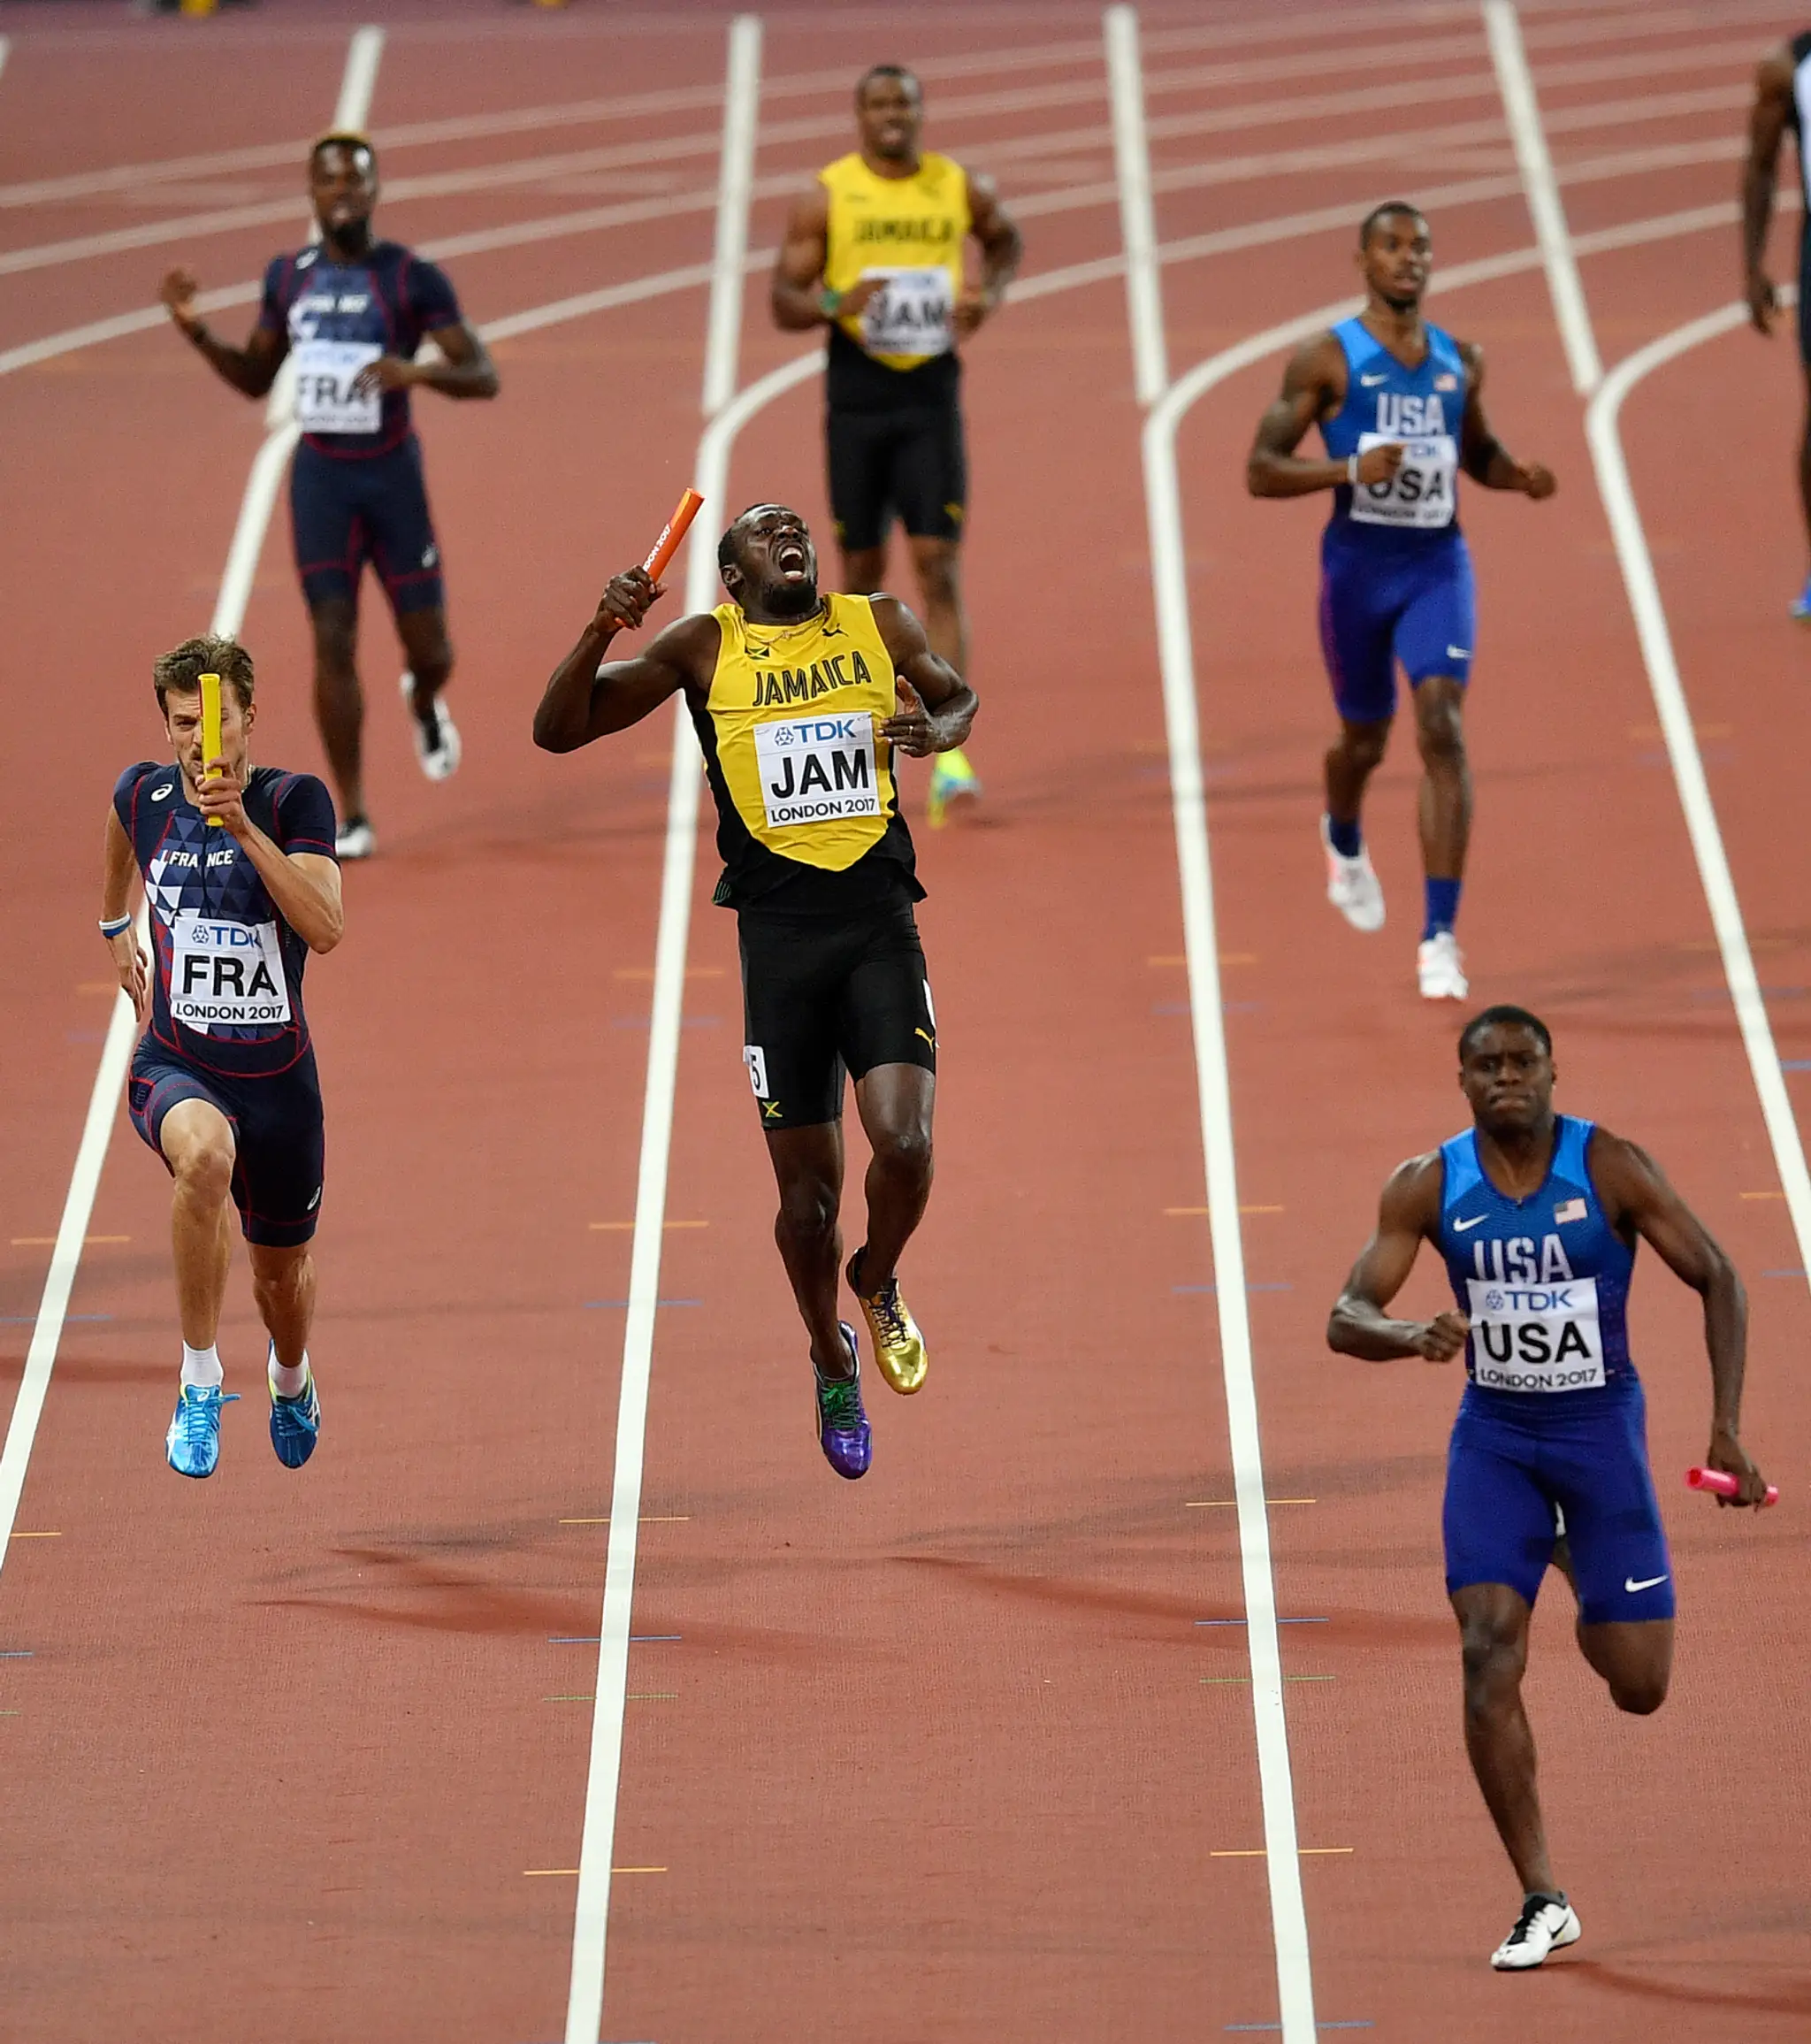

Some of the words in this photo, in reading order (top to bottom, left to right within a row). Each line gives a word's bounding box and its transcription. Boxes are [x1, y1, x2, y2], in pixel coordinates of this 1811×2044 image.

[1377, 393, 1447, 436] USA
[656, 524, 671, 547] 2017
[753, 651, 872, 707] JAMAICA
[793, 719, 857, 744] TDK
[771, 748, 869, 799] JAM
[771, 800, 843, 823] LONDON
[844, 798, 875, 813] 2017
[209, 925, 263, 948] TDK
[182, 954, 279, 997] FRA
[176, 1003, 245, 1020] LONDON
[248, 1005, 284, 1019] 2017
[1473, 1233, 1574, 1282] USA
[1505, 1289, 1573, 1311] TDK
[1480, 1320, 1592, 1364] USA
[1480, 1368, 1554, 1389] LONDON
[1556, 1368, 1598, 1386] 2017
